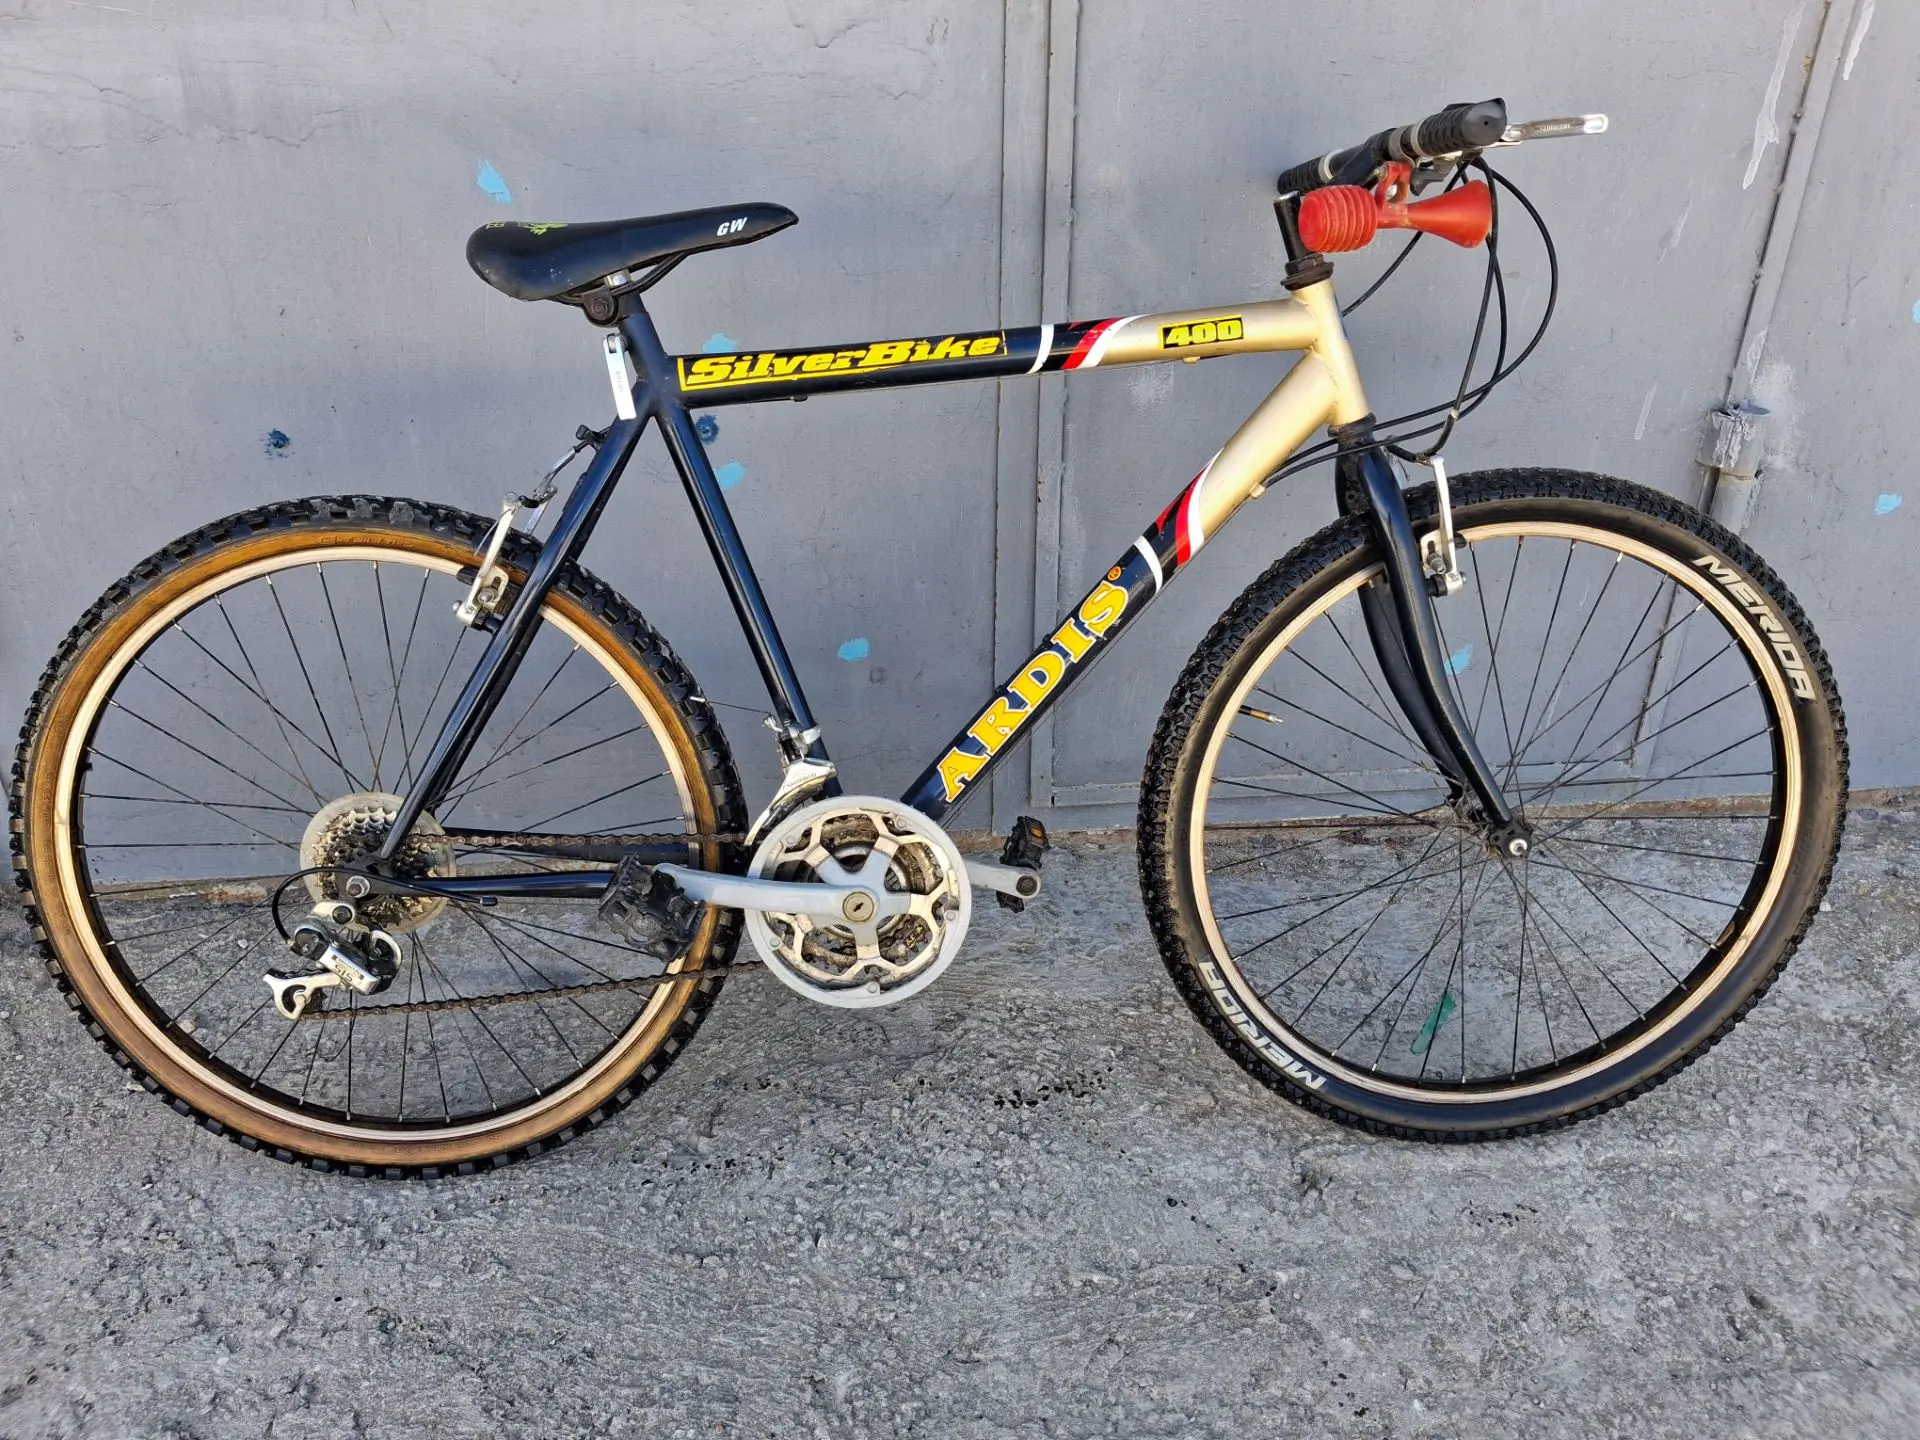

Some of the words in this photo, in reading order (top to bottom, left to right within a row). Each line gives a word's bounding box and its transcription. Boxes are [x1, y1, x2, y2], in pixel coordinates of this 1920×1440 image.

[717, 217, 748, 236] GW
[687, 337, 1000, 385] SilverBike
[1166, 320, 1242, 345] 400
[1692, 555, 1816, 700] MERIDA
[937, 580, 1129, 802] ARDIS
[1199, 962, 1327, 1090] MERIDA
